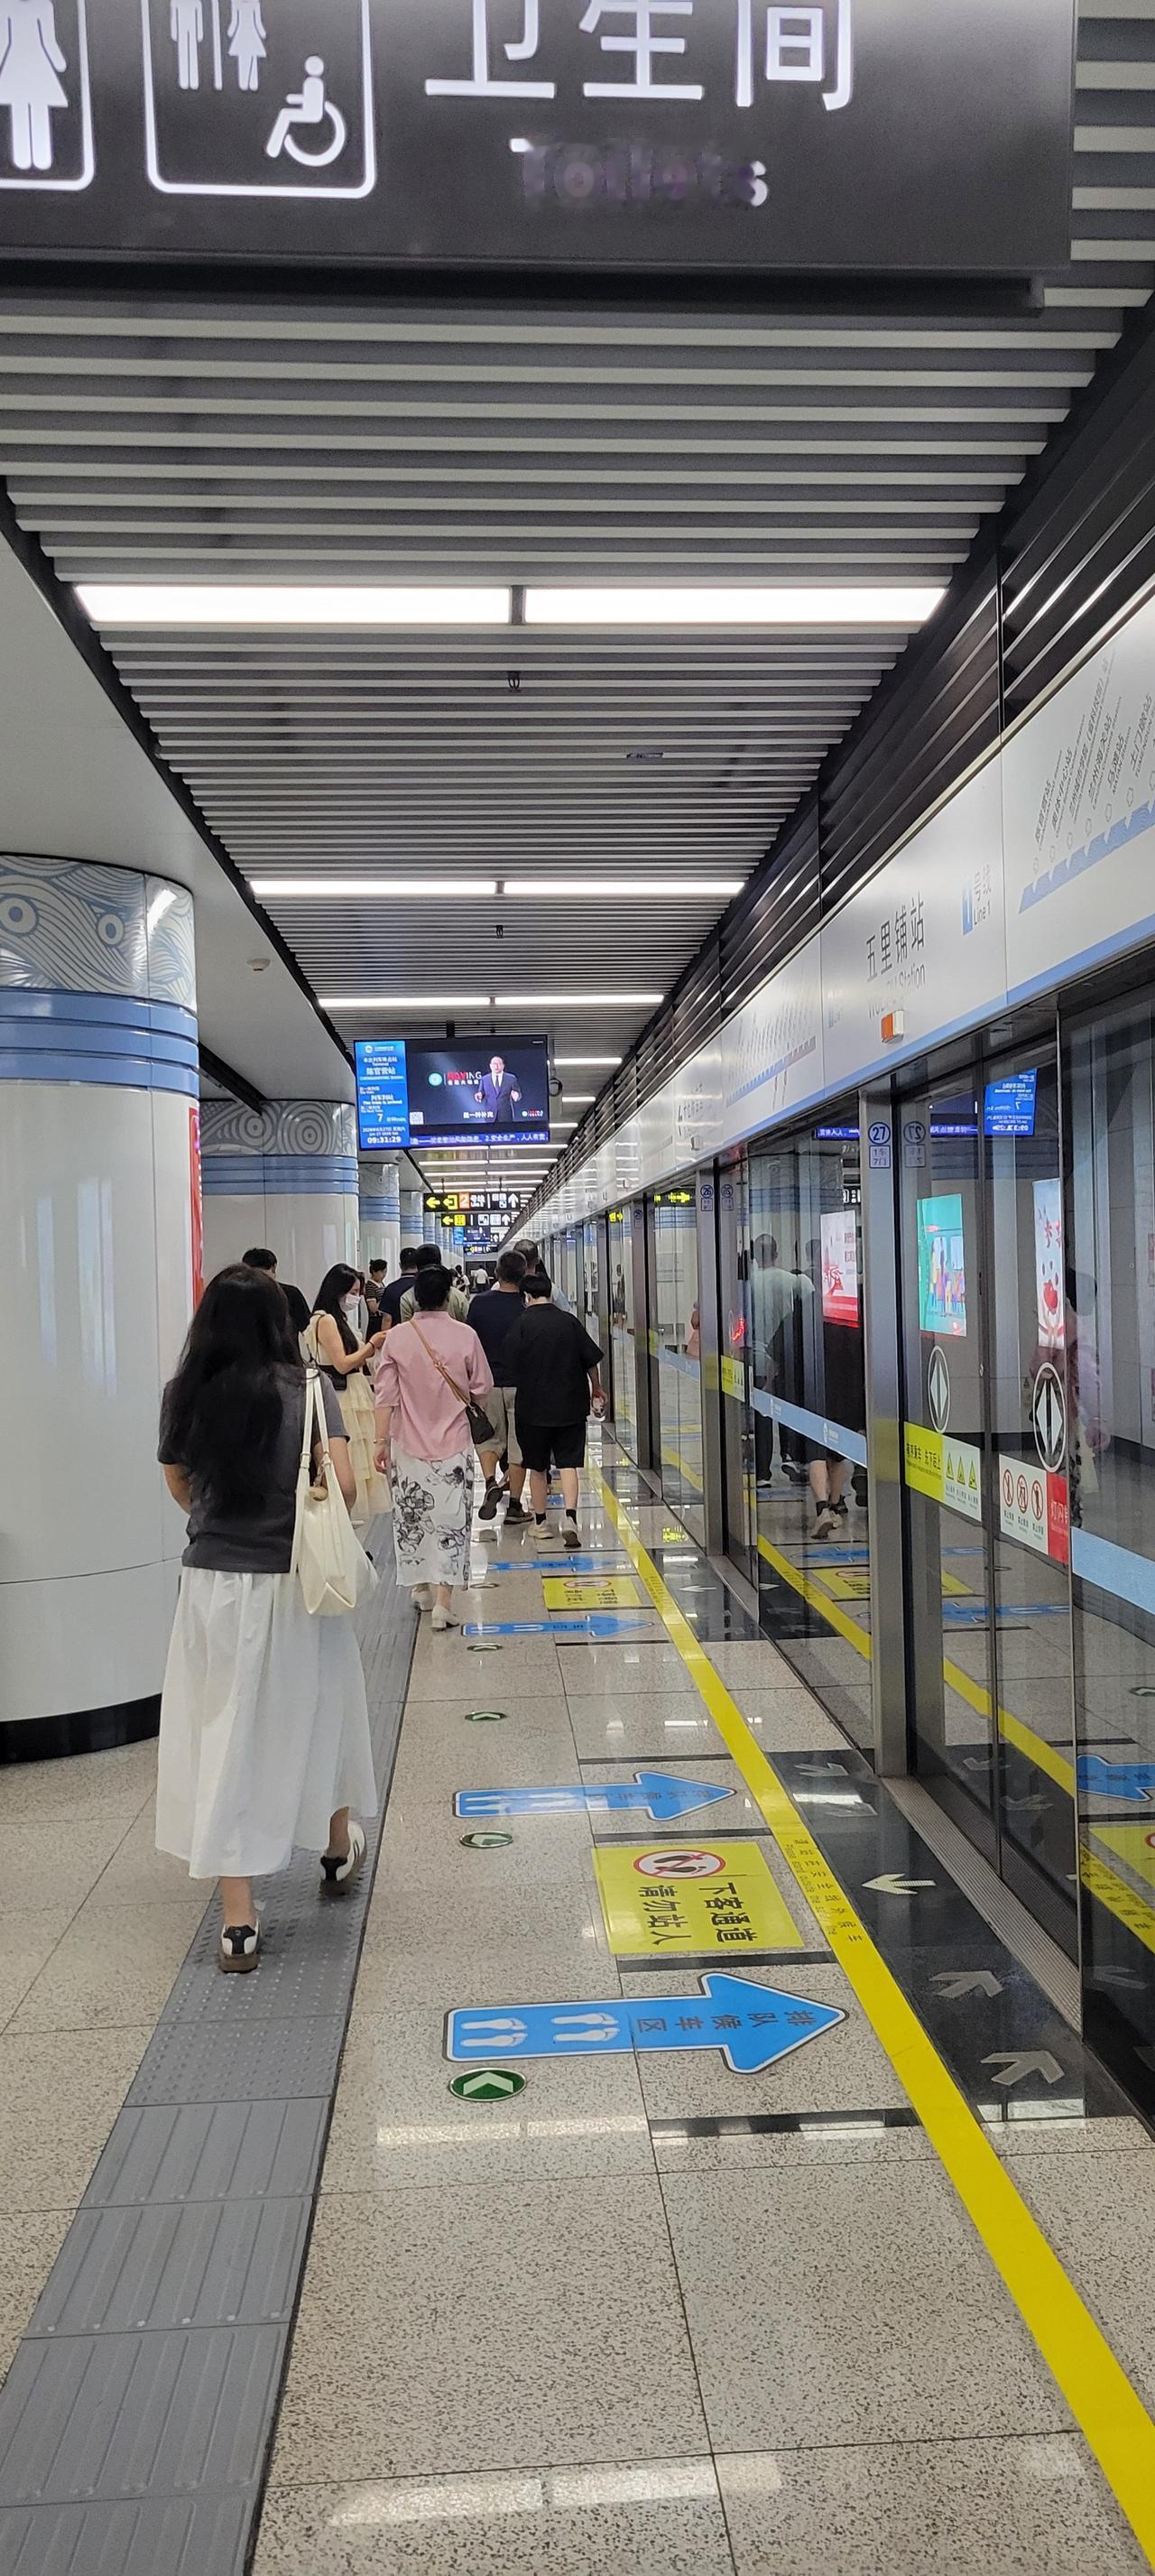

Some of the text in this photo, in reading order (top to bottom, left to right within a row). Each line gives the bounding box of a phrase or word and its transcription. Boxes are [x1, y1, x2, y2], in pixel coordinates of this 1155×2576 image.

[425, 0, 853, 111] 卫生间
[866, 889, 925, 983] 五里铺站
[377, 1113, 383, 1123] 7
[873, 1126, 886, 1141] 27
[638, 1885, 692, 1945] 请勿站人
[698, 1882, 759, 1943] 下客通道
[637, 2011, 817, 2033] 排队候车区
